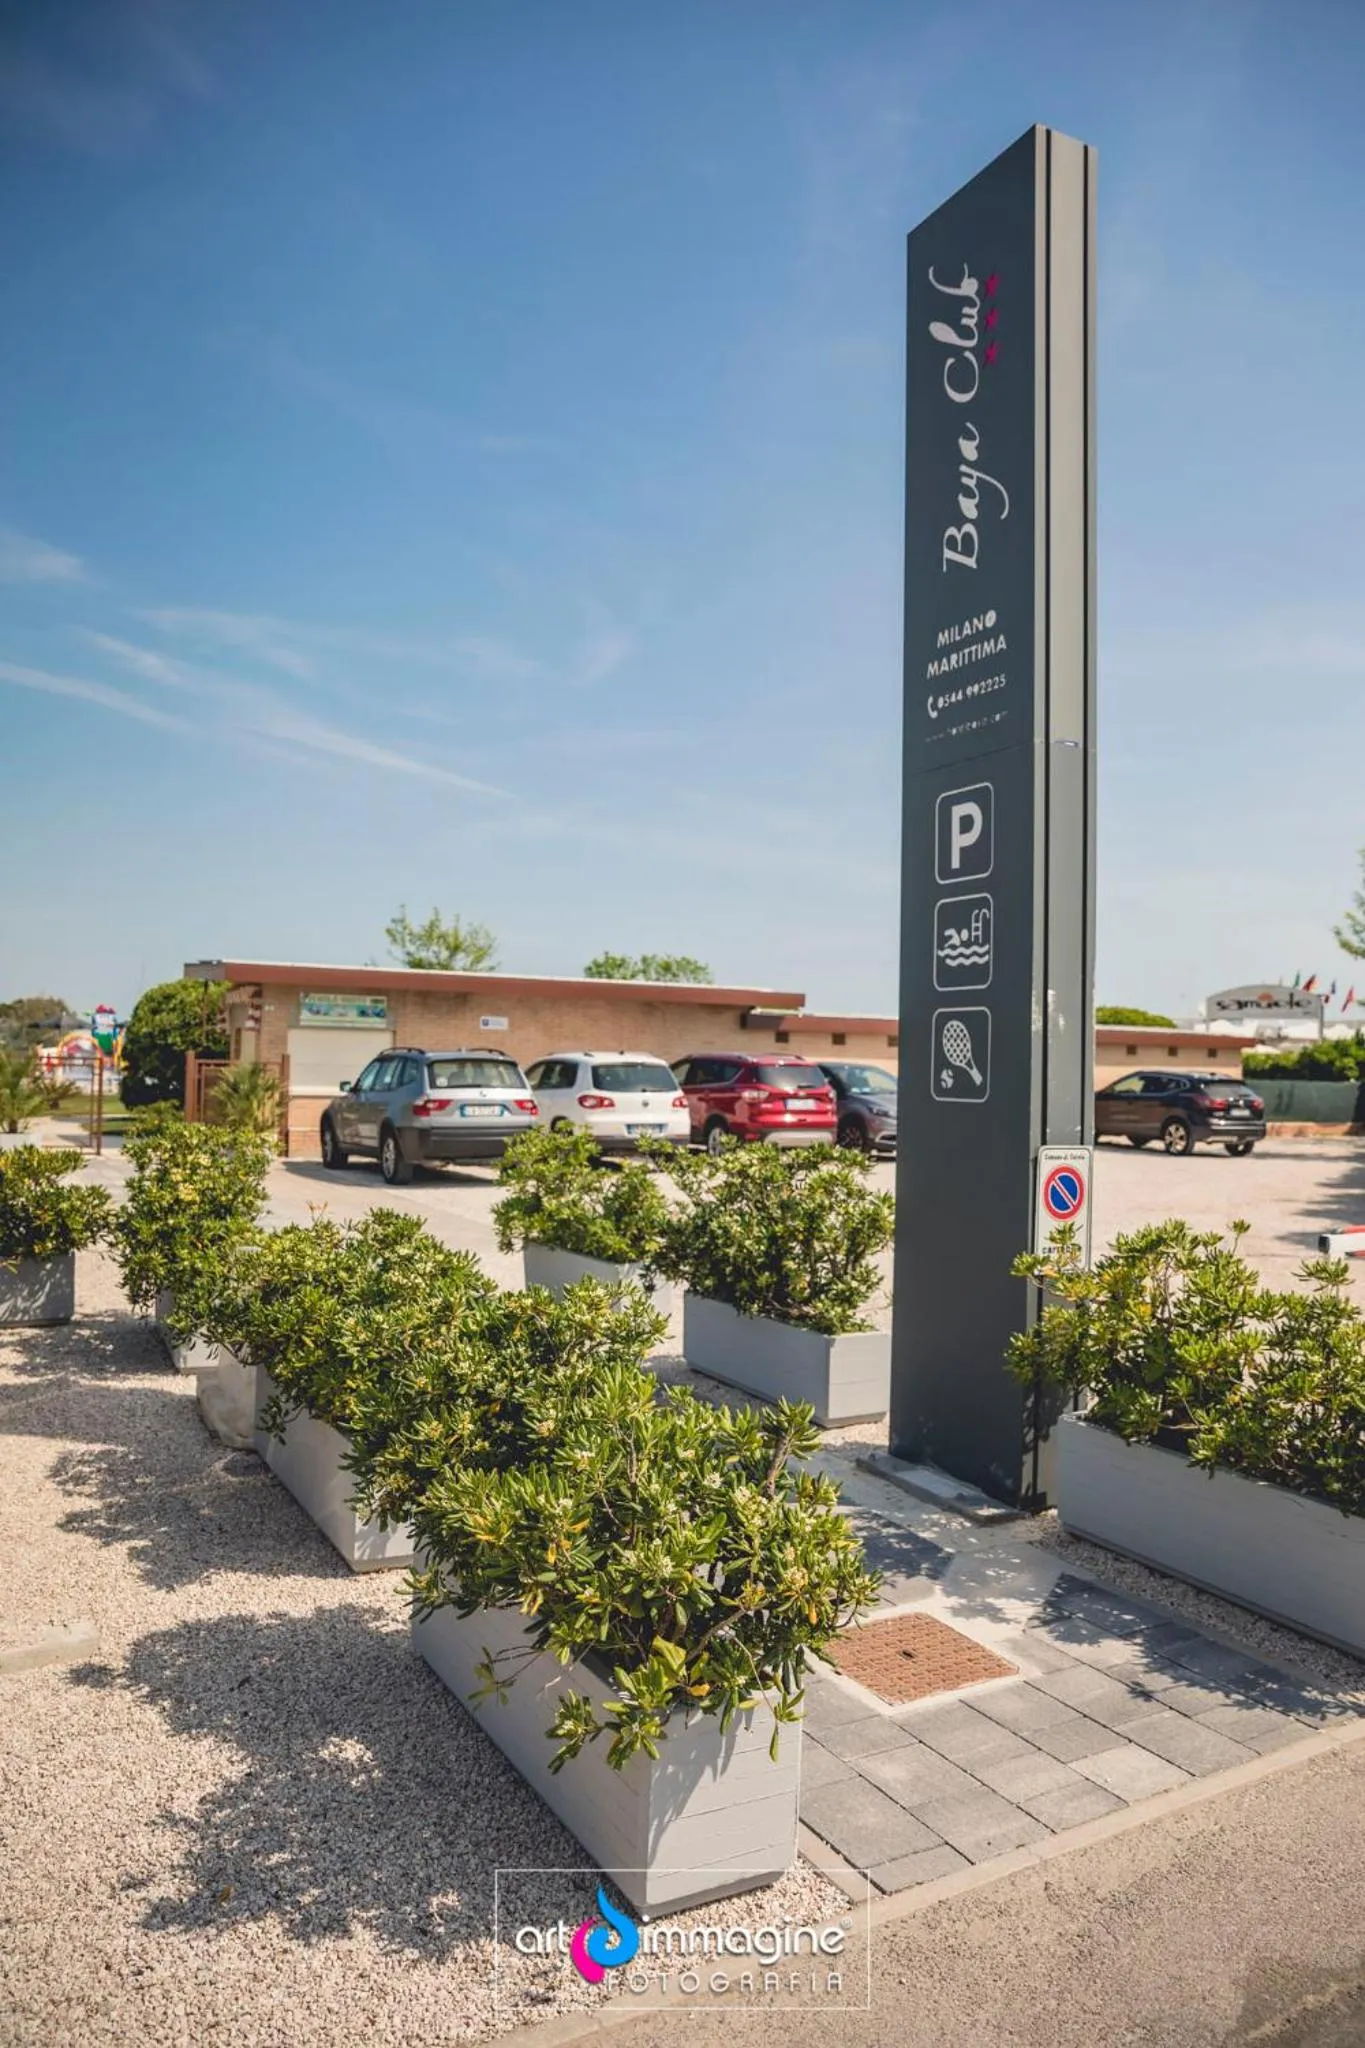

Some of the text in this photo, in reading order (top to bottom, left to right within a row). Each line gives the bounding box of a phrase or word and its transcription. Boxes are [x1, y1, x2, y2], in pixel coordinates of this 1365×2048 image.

[928, 262, 1010, 573] Baya Club
[936, 609, 997, 649] MILANO
[926, 633, 1007, 679] MARITTIMA
[937, 689, 963, 709] 0544
[951, 801, 983, 870] P
